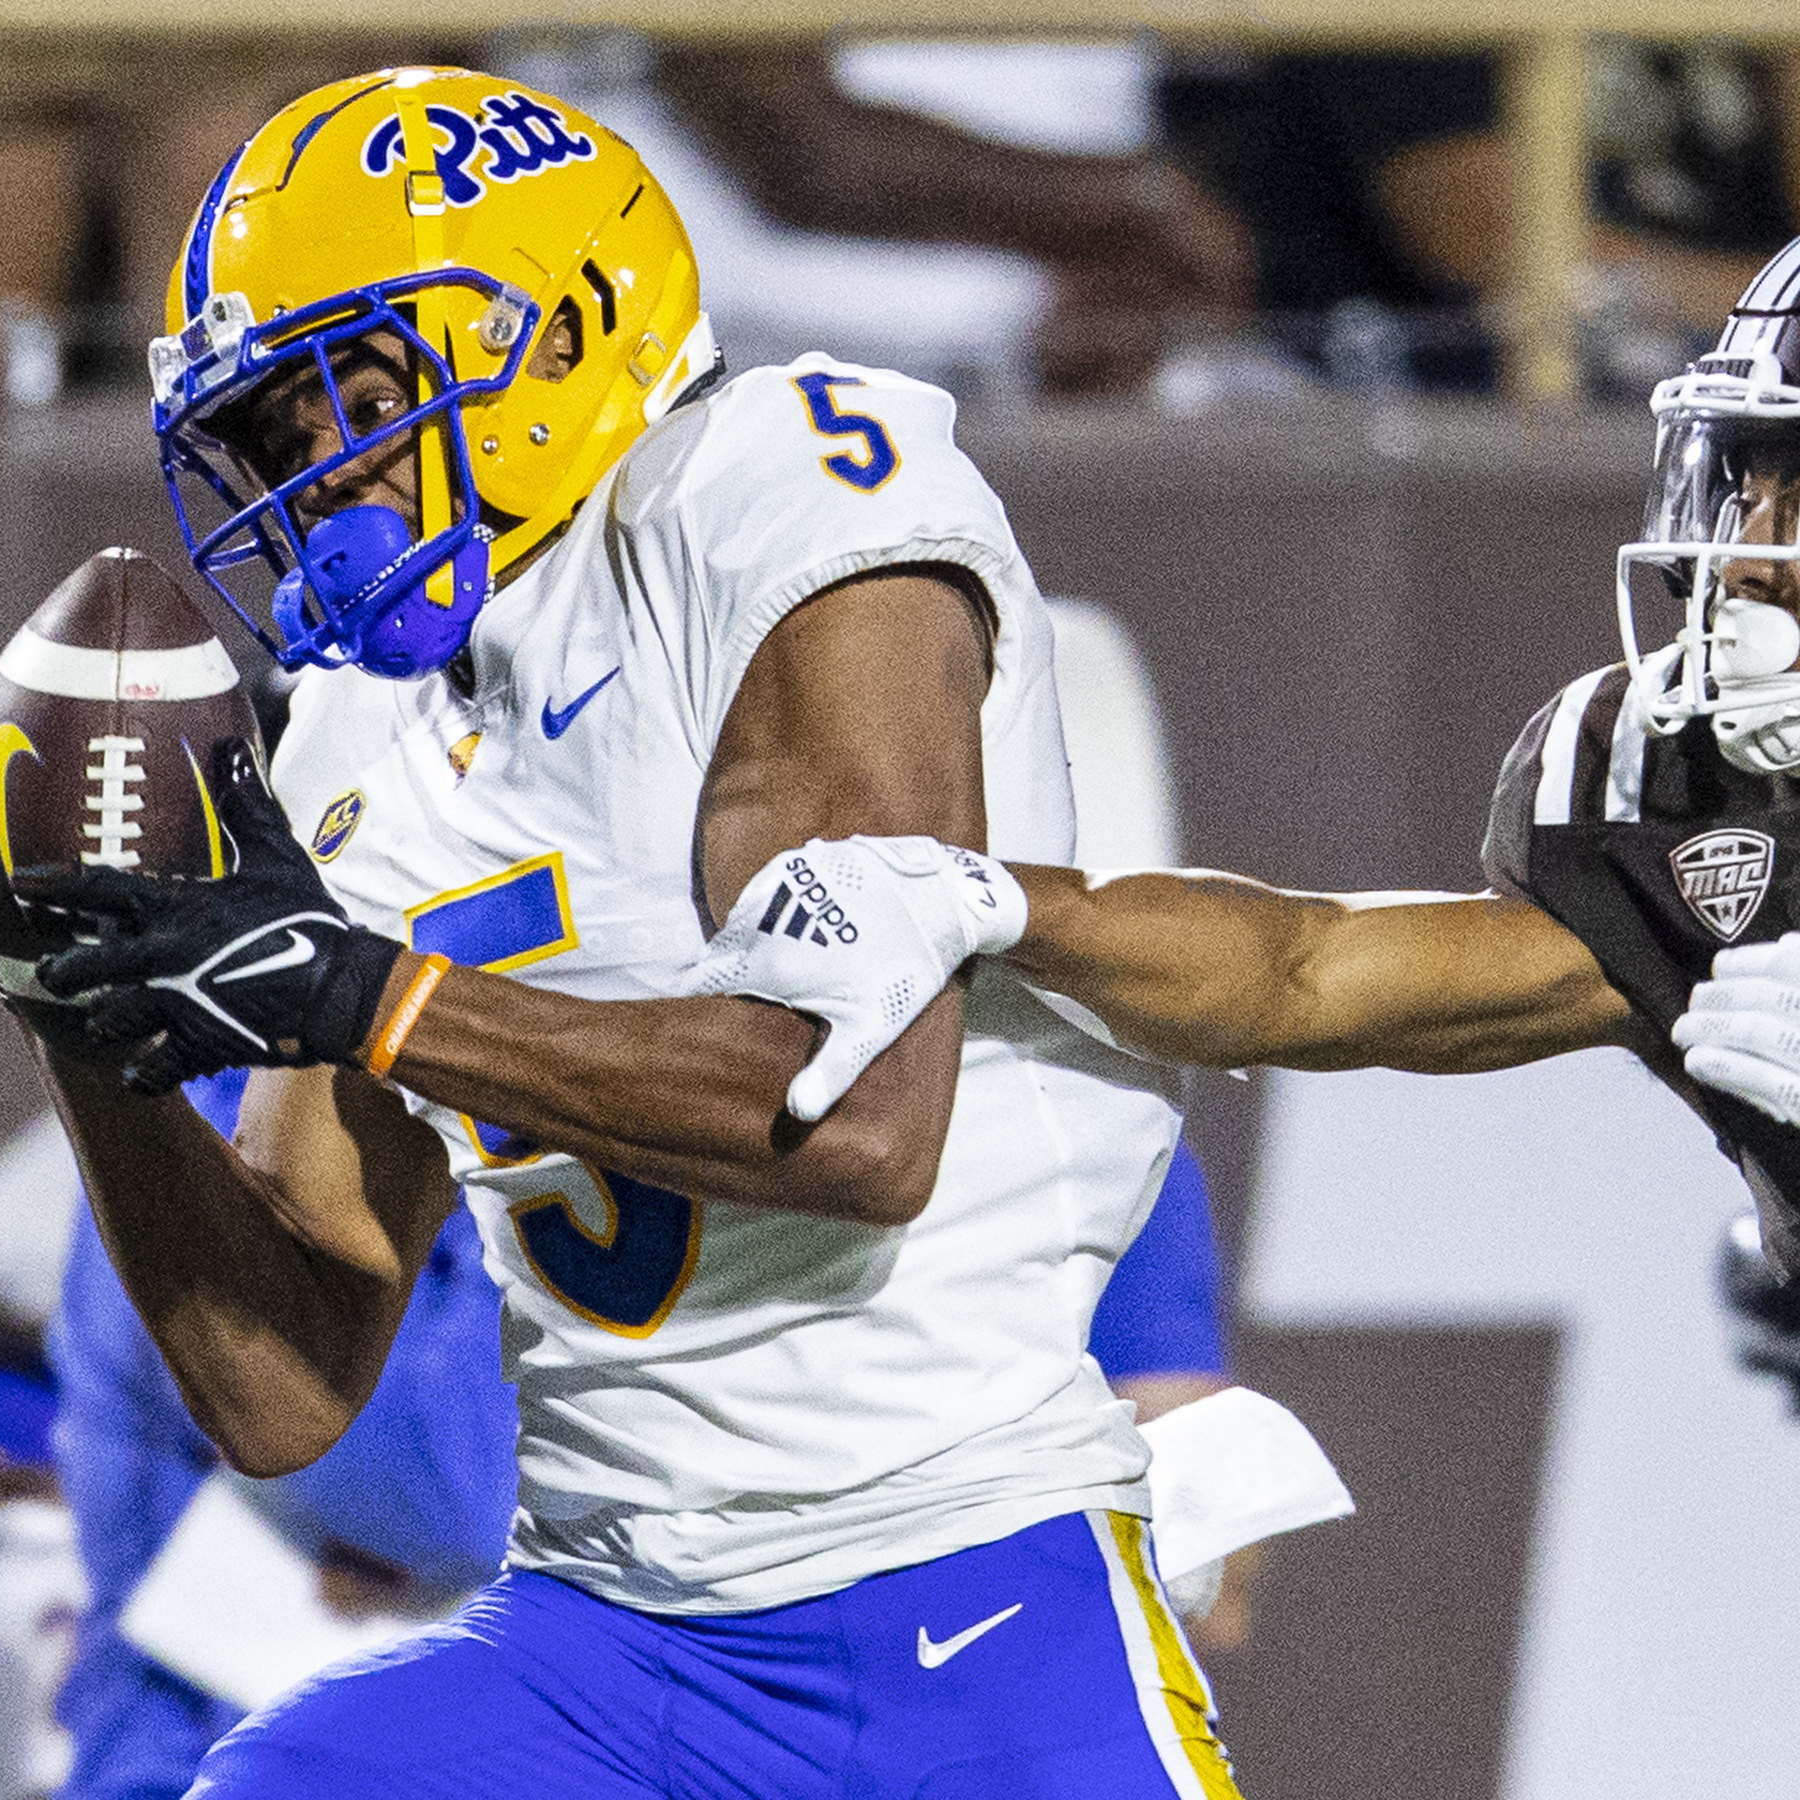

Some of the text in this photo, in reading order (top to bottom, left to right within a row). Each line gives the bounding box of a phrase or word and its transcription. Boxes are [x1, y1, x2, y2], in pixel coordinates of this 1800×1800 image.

[360, 89, 598, 208] Pitt
[787, 371, 902, 496] 5
[784, 856, 860, 946] adidas
[1683, 860, 1768, 899] MAC
